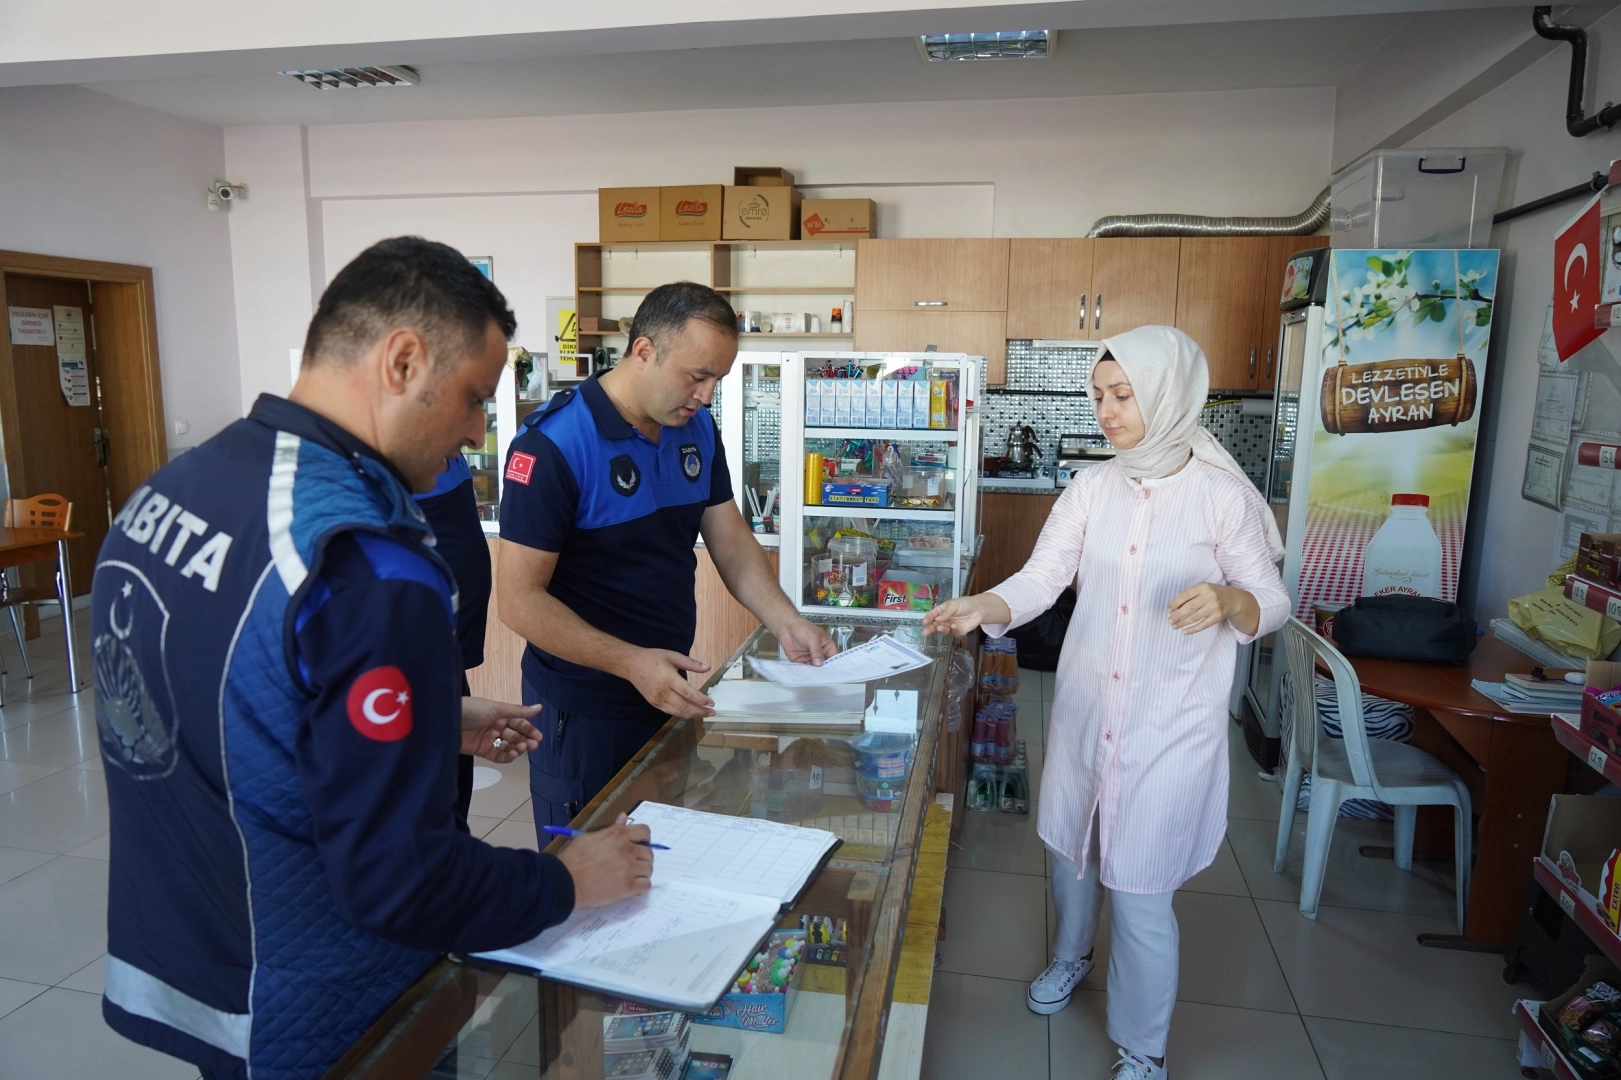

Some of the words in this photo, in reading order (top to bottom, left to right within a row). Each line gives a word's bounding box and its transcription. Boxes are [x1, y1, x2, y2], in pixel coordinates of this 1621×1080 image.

[617, 201, 644, 214] Lezita
[678, 200, 705, 213] Lezita
[741, 207, 768, 217] emre
[1351, 363, 1449, 385] LEZZETİYLE
[1340, 378, 1460, 406] DEVLEŞEN
[1367, 403, 1434, 424] AYRAN
[1371, 567, 1410, 578] Geleneksel
[1374, 585, 1396, 597] EKER
[884, 593, 907, 603] First
[1611, 882, 1620, 911] EXTRA
[737, 1003, 768, 1018] Hair
[741, 1015, 779, 1028] Master
